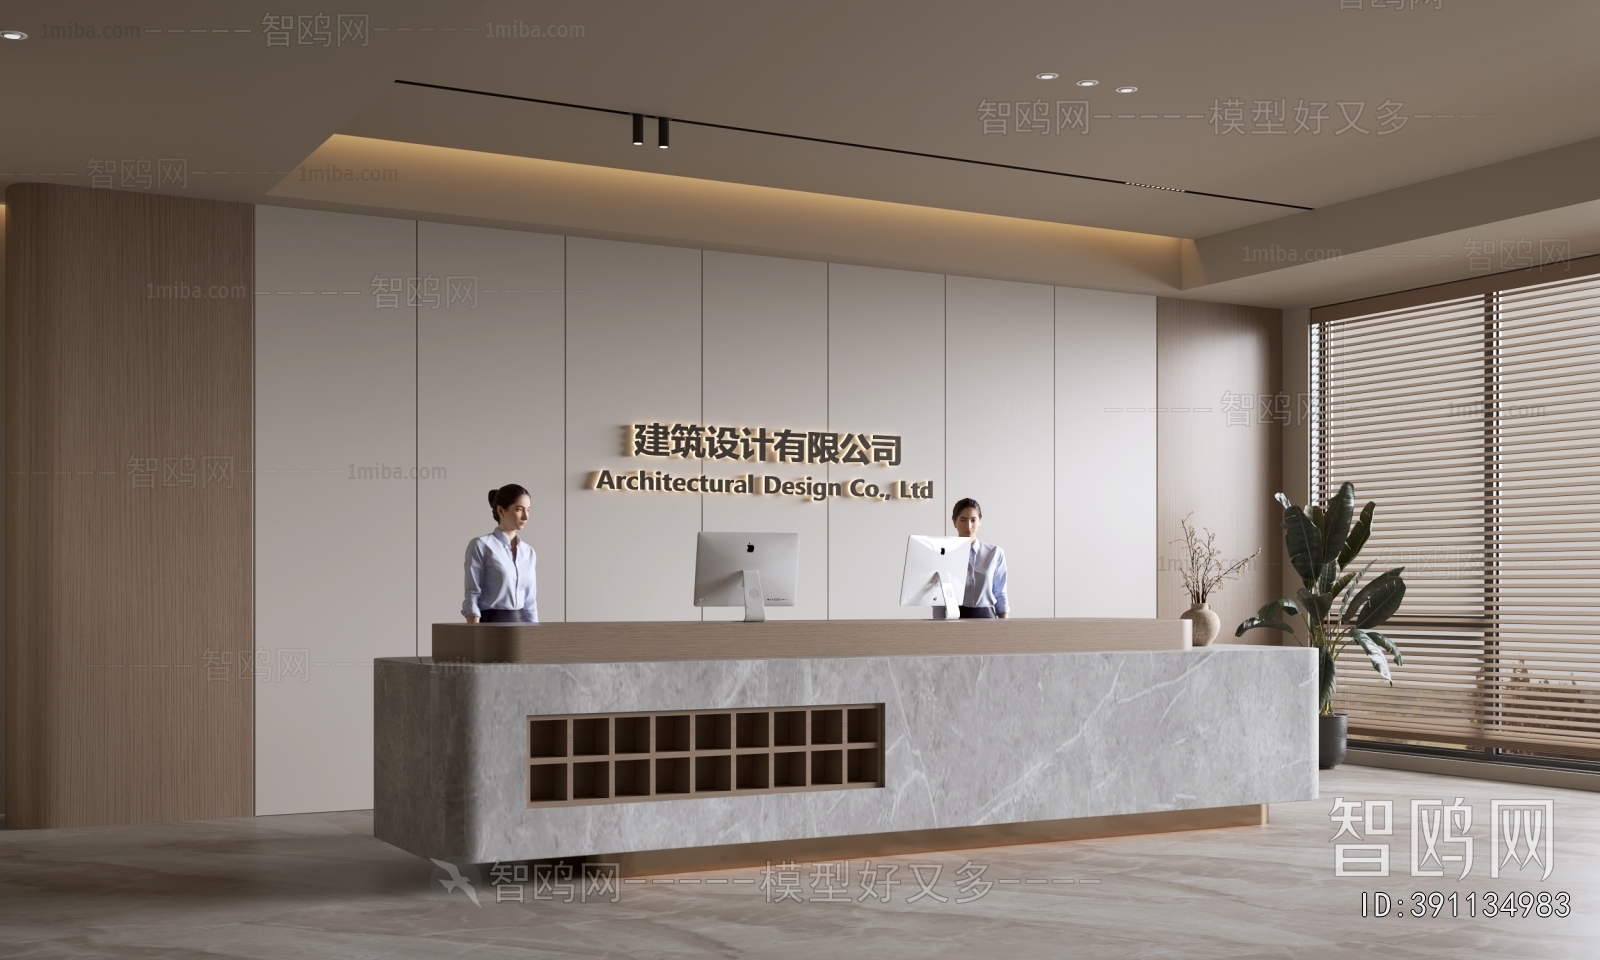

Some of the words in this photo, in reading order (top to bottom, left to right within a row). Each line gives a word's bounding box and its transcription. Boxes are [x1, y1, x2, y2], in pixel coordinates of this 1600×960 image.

[633, 422, 903, 467] 建筑设计有限公司
[594, 469, 756, 496] Architectural
[763, 475, 842, 502] Design
[900, 481, 935, 500] Ltd
